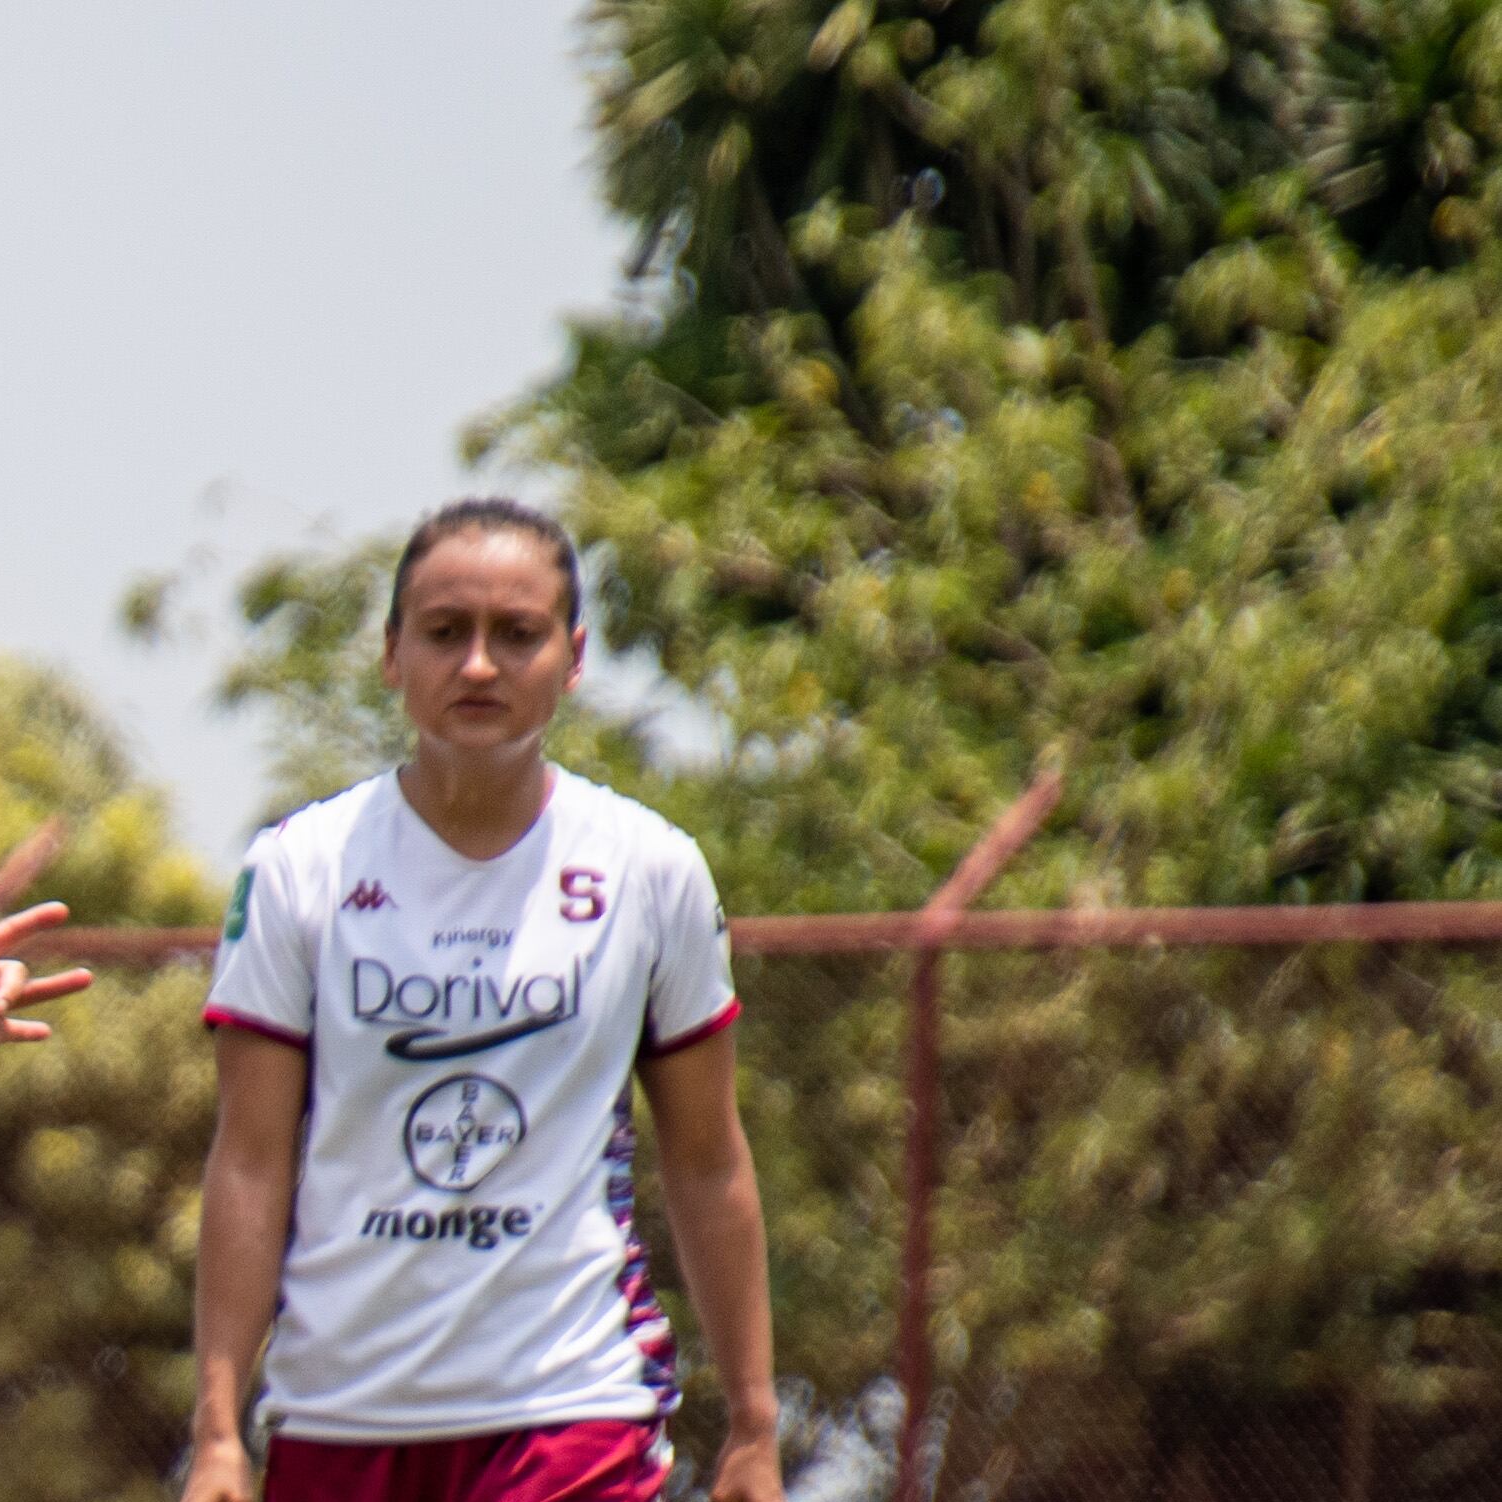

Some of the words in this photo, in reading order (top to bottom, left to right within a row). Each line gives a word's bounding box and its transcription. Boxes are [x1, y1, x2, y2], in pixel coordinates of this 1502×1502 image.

[559, 866, 605, 922] S
[353, 954, 580, 1020] Dorival
[415, 1122, 513, 1146] BAYER
[448, 1081, 479, 1182] BAYER
[360, 1204, 533, 1250] monge
